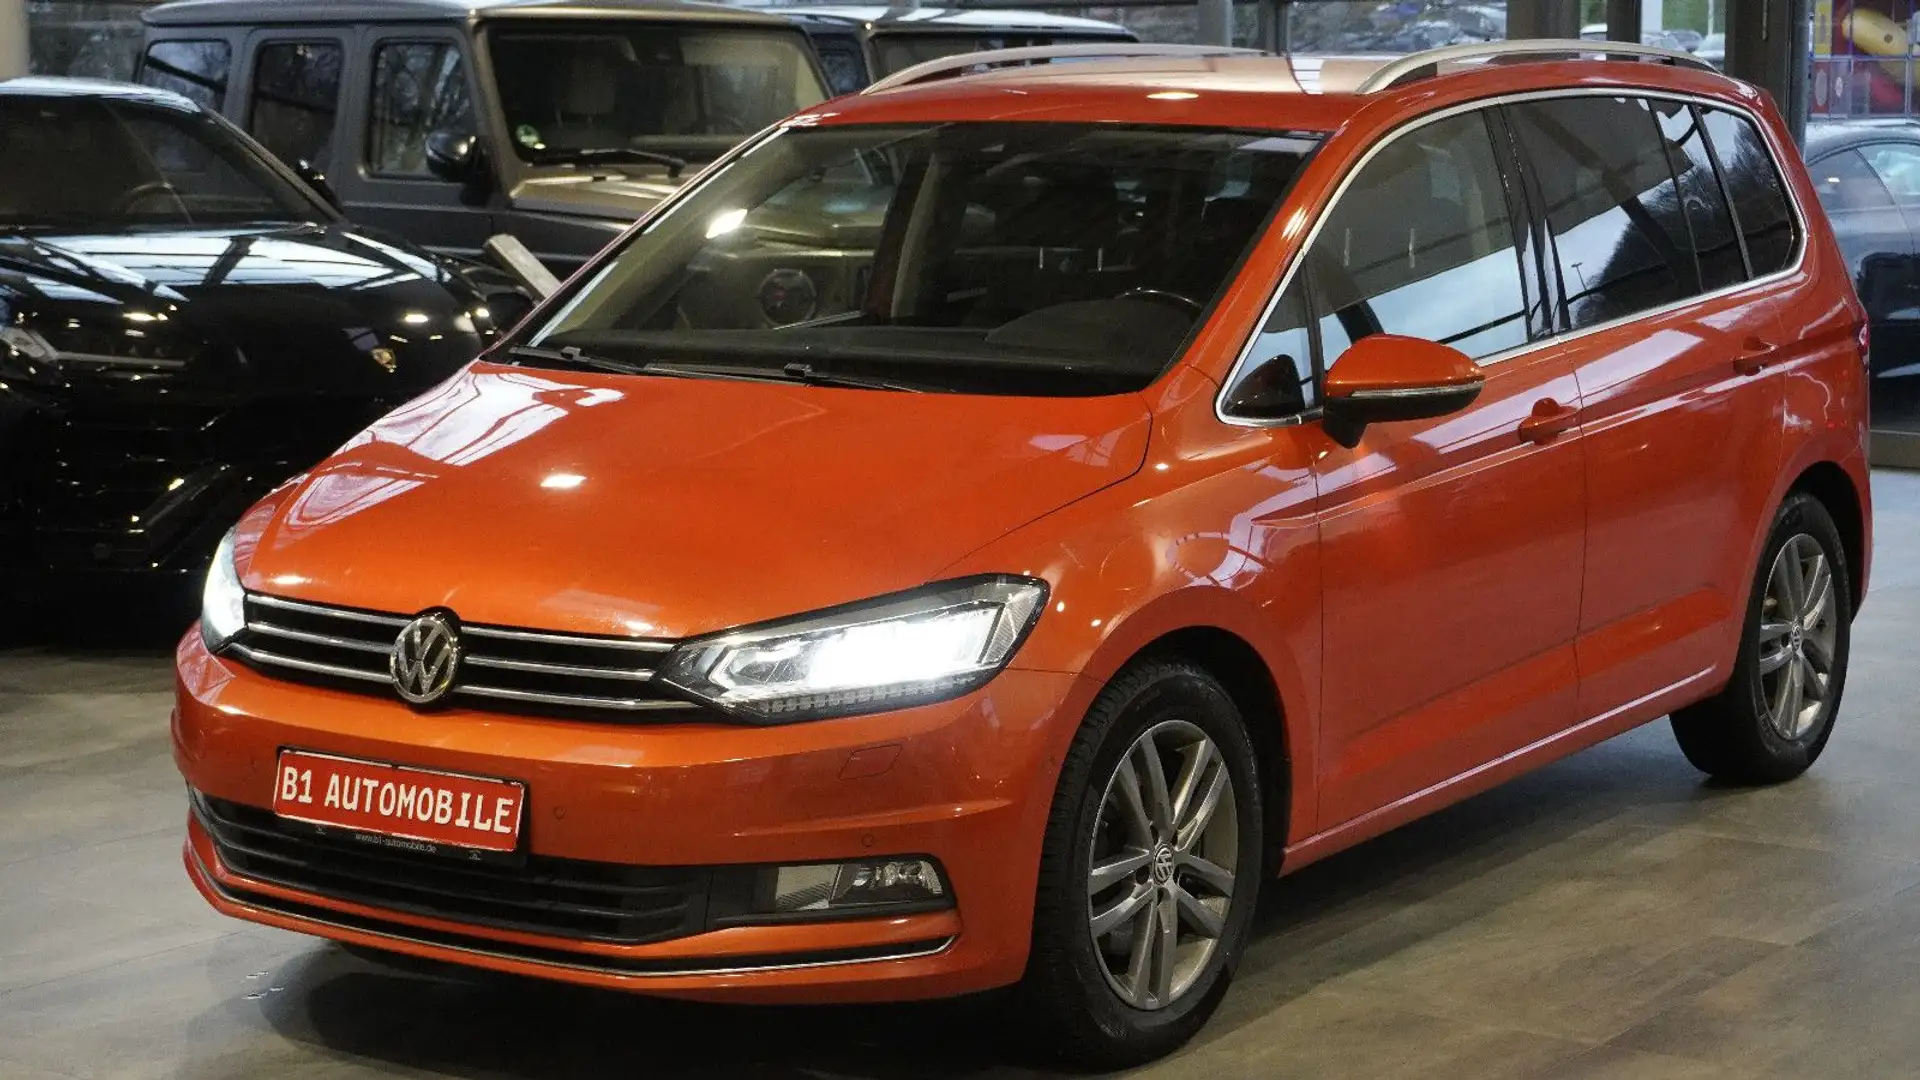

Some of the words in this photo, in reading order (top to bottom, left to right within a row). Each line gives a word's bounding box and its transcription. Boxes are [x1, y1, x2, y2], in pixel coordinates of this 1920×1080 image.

[391, 618, 457, 703] VW
[281, 766, 313, 804] B1
[324, 773, 514, 834] AUTOMOBILE
